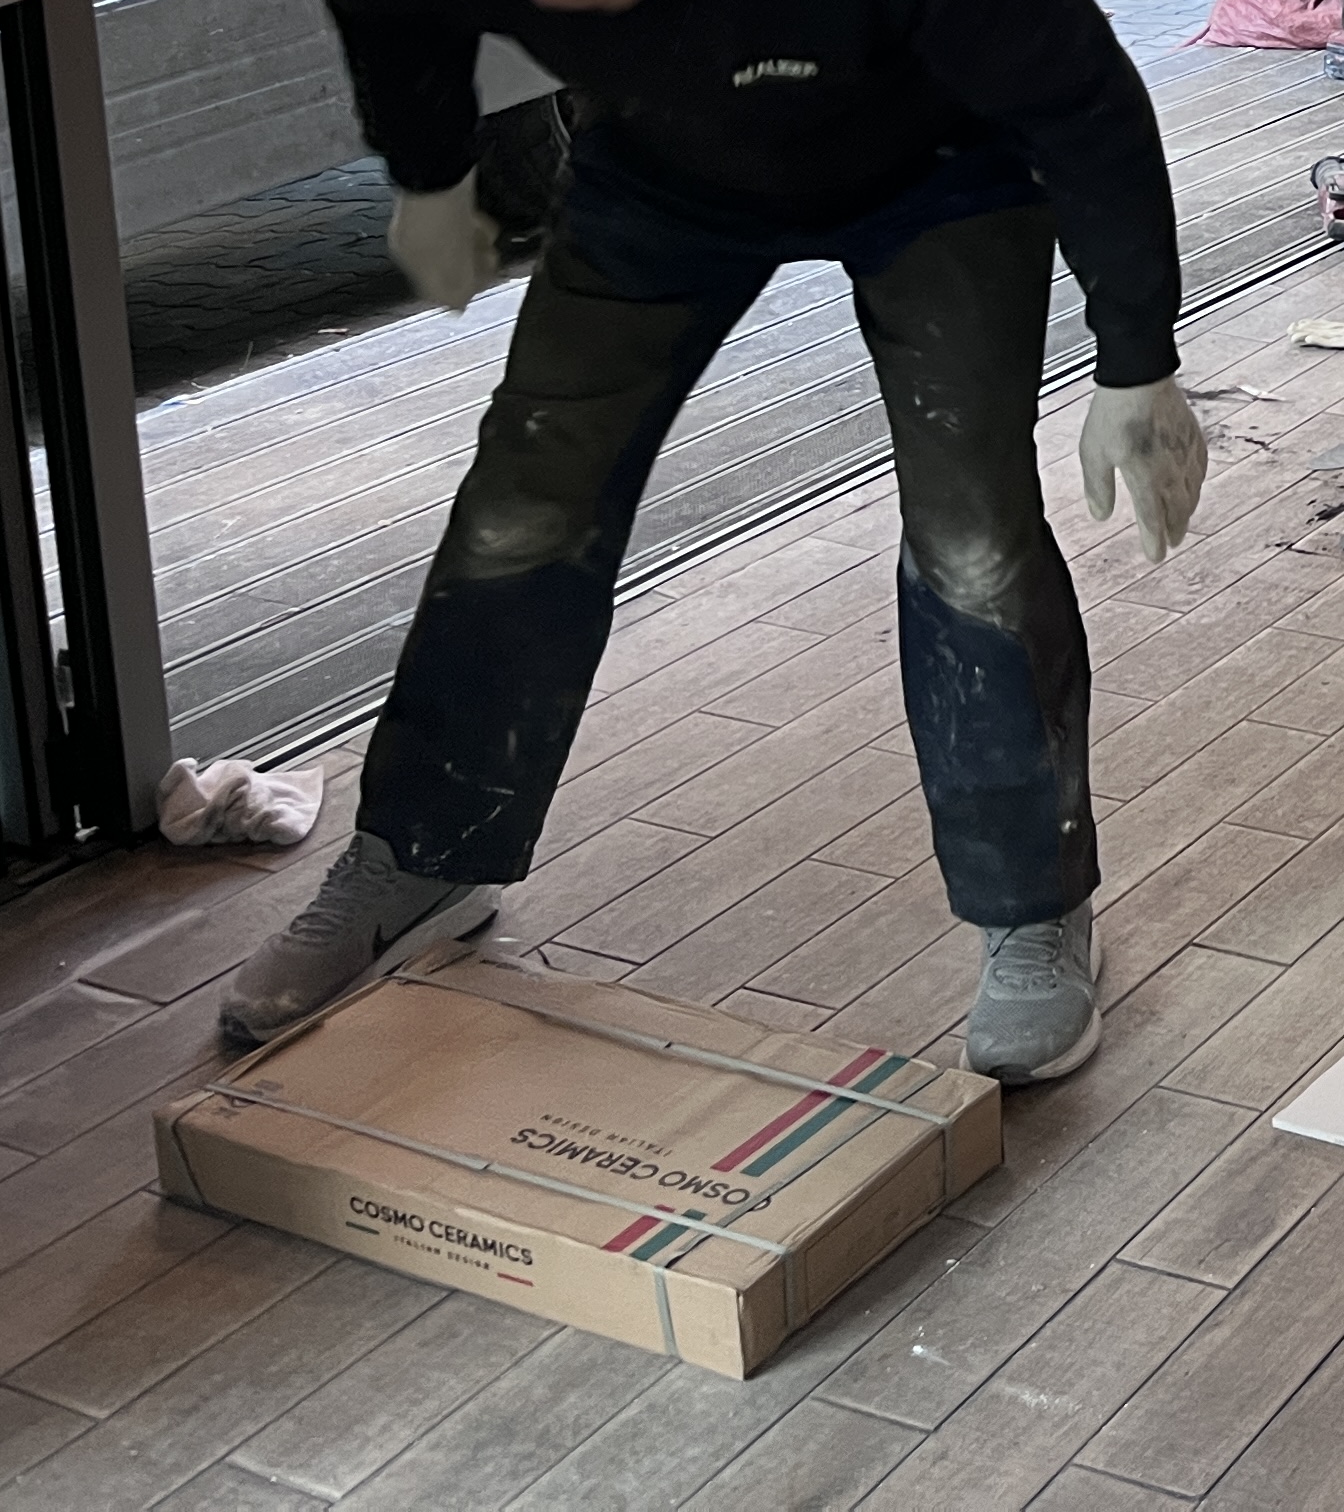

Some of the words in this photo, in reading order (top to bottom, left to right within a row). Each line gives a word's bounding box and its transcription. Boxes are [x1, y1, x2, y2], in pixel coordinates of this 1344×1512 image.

[510, 1127, 660, 1181] CERAMICS
[349, 1195, 425, 1233] COSMO
[428, 1219, 534, 1266] CERAMICS
